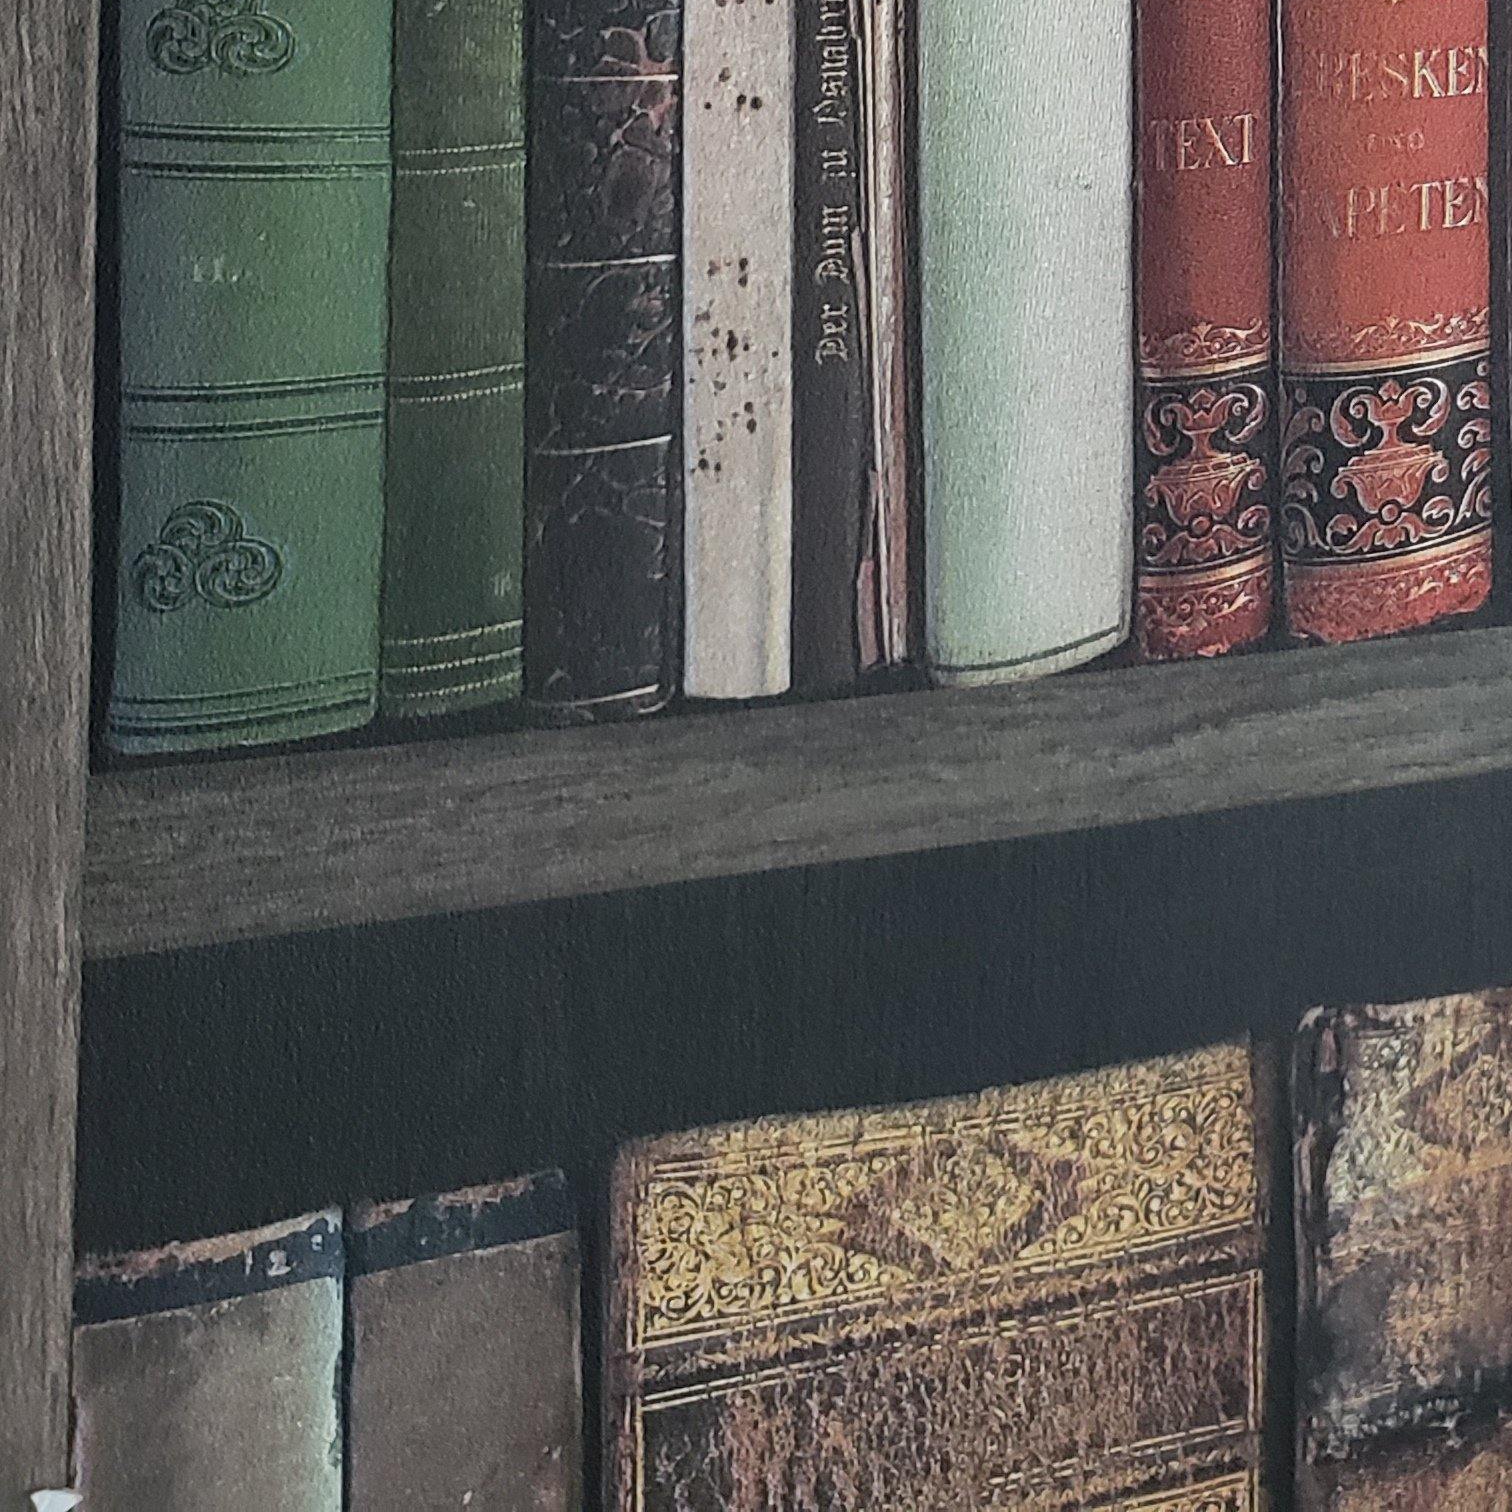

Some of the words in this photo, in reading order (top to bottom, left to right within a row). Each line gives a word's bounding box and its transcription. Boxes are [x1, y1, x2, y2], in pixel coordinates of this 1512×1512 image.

[1148, 112, 1257, 172] TEXT
[815, 205, 850, 285] Dom
[815, 304, 850, 366] Der
